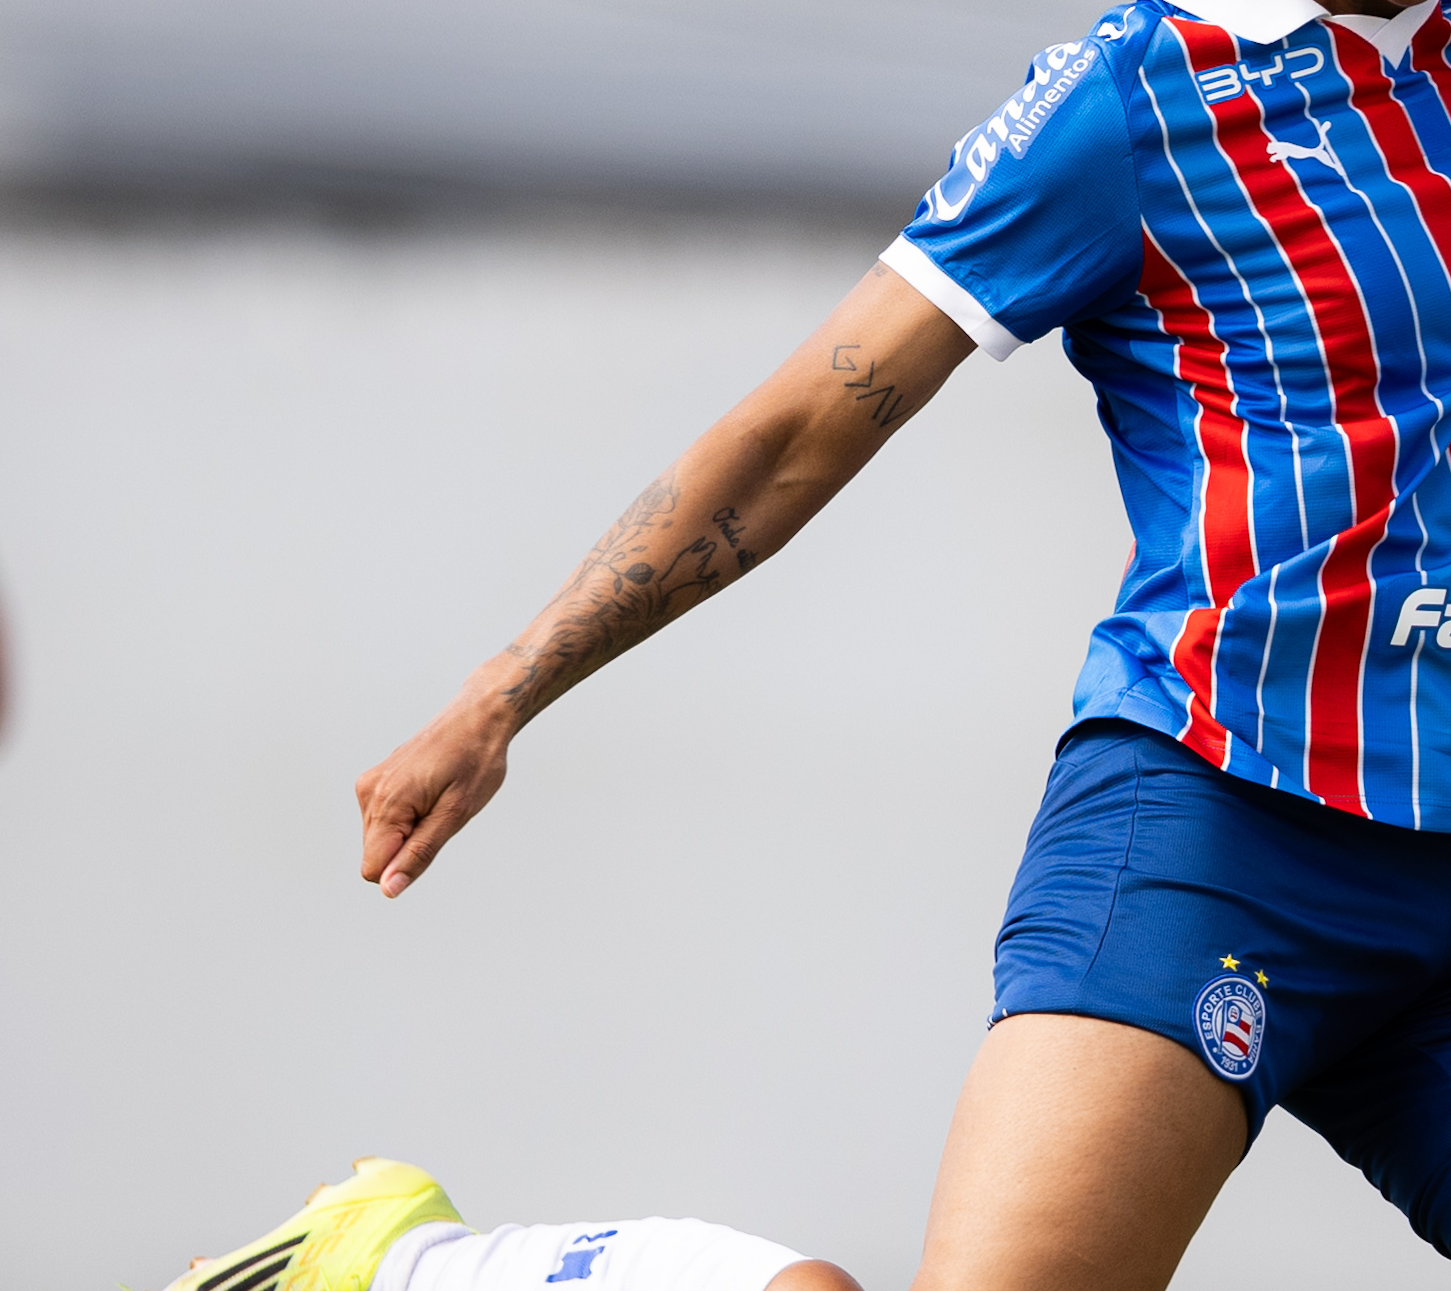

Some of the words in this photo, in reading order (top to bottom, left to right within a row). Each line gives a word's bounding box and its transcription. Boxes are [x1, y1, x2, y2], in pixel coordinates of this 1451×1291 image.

[1009, 49, 1096, 153] Alimentos
[1198, 47, 1325, 101] BYD
[1201, 985, 1233, 1040] ESPORTE
[1235, 984, 1262, 1020] CLUBE
[1221, 1055, 1239, 1072] 1931
